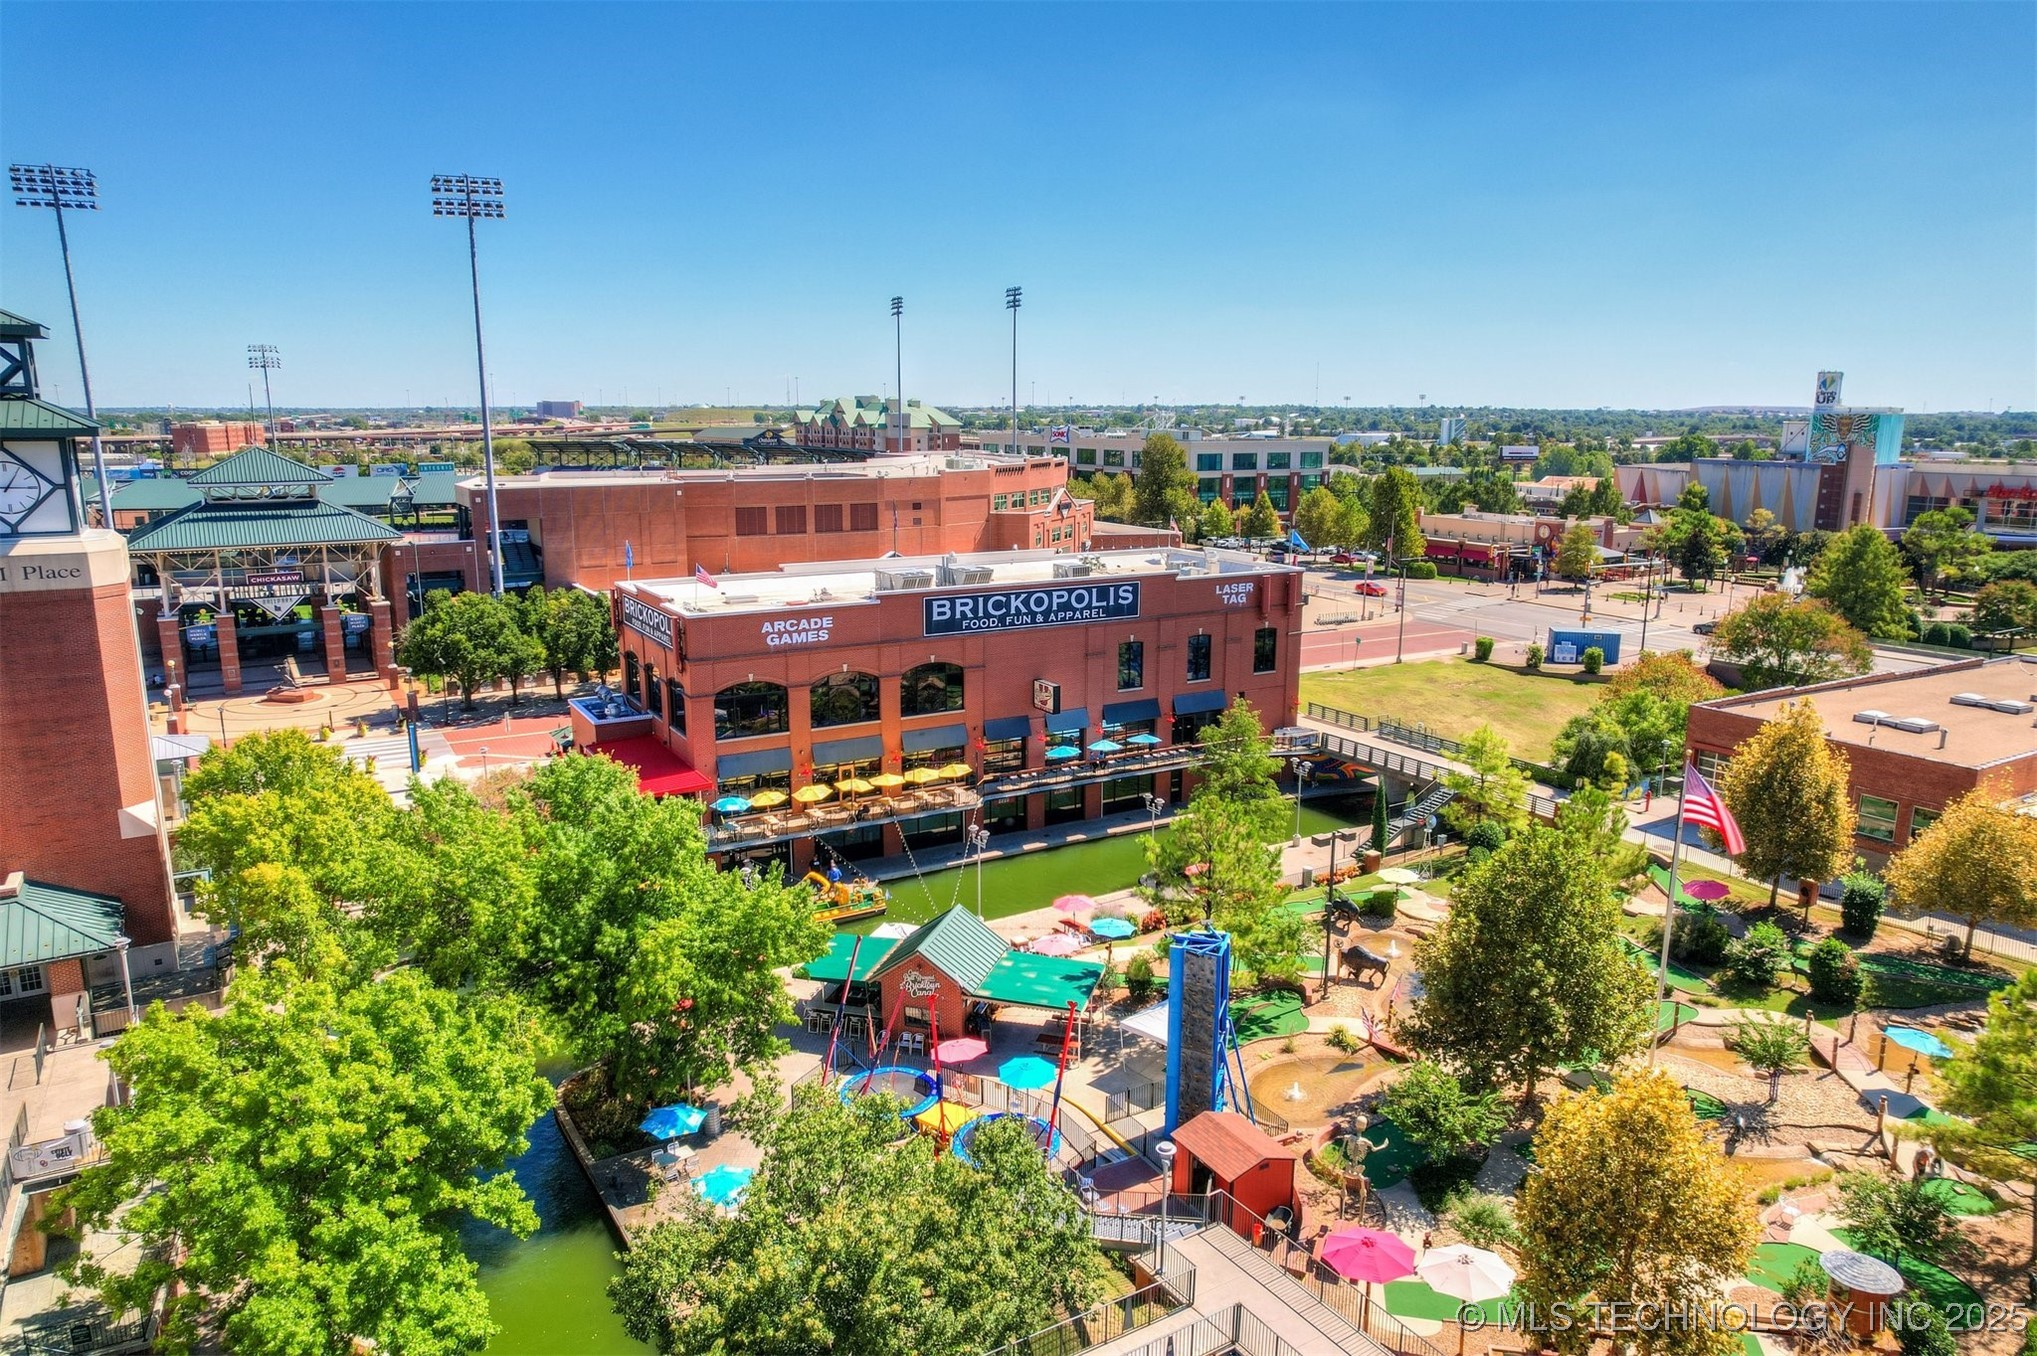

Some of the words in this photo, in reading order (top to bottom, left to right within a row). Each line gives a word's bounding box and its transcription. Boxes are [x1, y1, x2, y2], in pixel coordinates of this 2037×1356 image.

[1816, 395, 1836, 404] UP
[22, 565, 82, 580] Place
[250, 575, 300, 584] CHICKASAW
[1215, 582, 1254, 595] LASER
[932, 585, 1134, 621] BRICKOPOLIS
[1222, 593, 1247, 605] TAG
[761, 616, 834, 634] ARCADE
[962, 617, 1002, 630] FOOD,
[1006, 614, 1032, 626] FUN
[1035, 613, 1044, 623] &
[1048, 608, 1106, 622] APPAREL
[766, 629, 830, 646] GAMES
